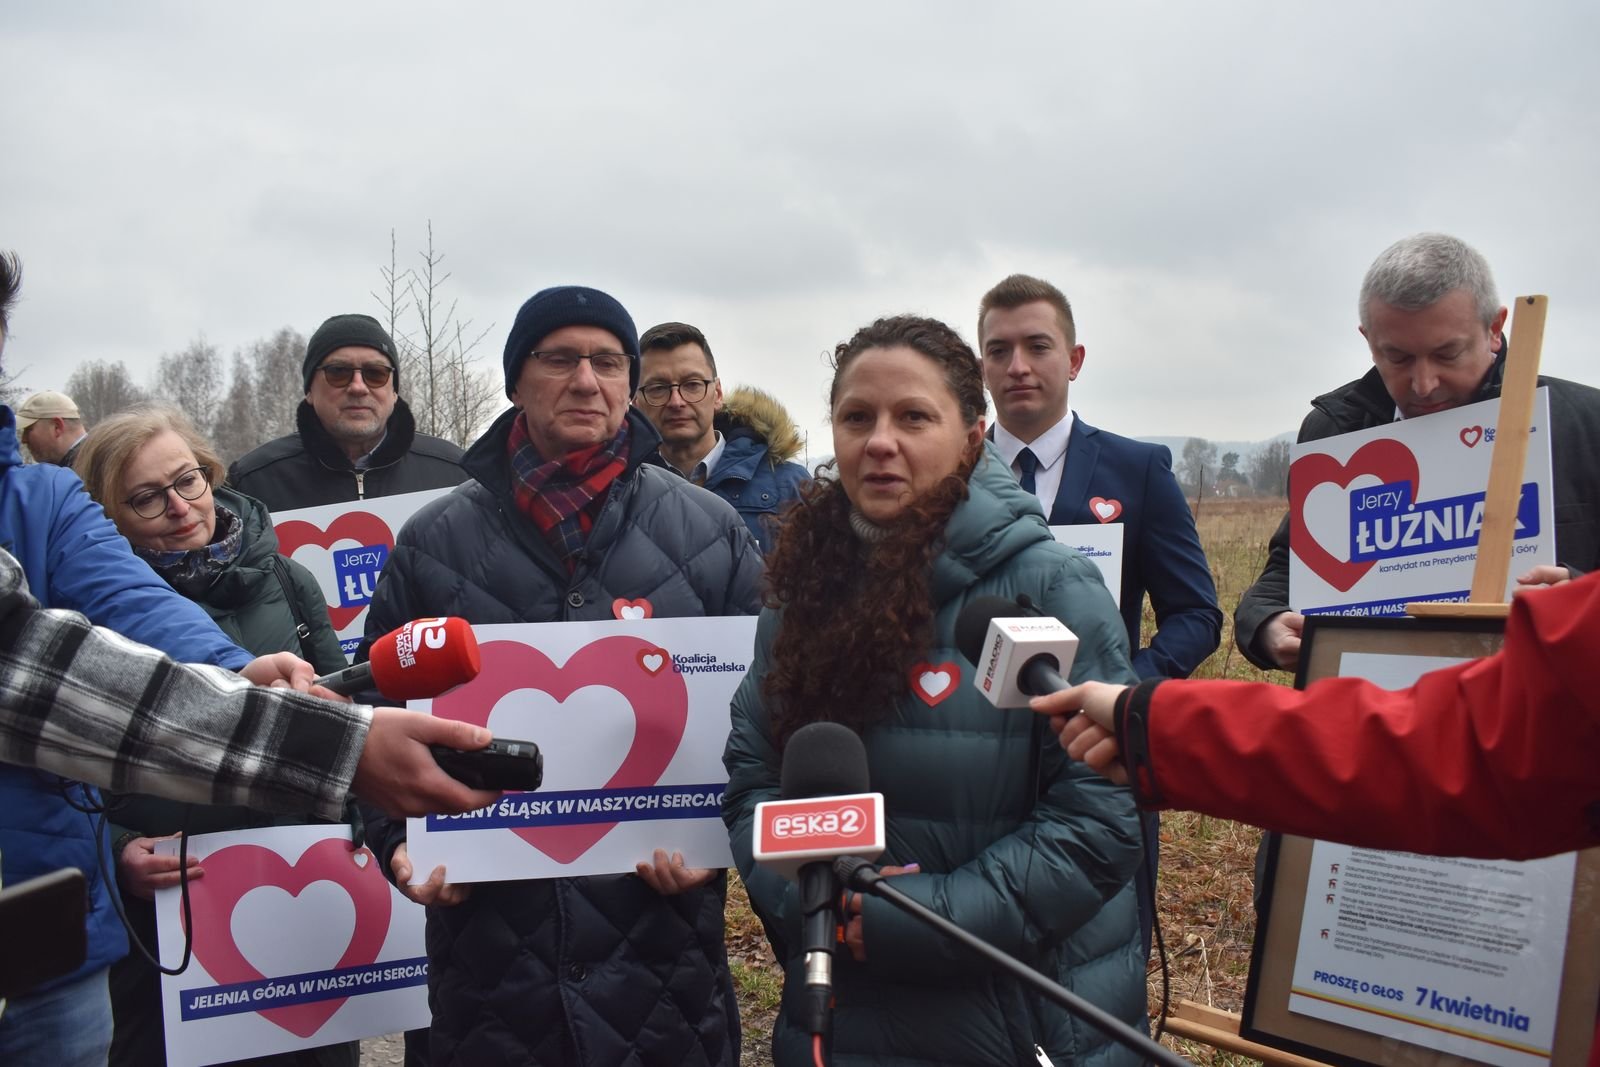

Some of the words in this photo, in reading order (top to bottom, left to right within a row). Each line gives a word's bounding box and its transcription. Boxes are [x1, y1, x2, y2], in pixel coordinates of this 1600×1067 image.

[1357, 490, 1402, 512] Jerzy
[1356, 495, 1526, 555] ŁUŻNIA
[341, 551, 381, 567] Jerzy
[1379, 560, 1418, 573] kandydat
[1516, 545, 1538, 557] Góry
[395, 633, 409, 668] RADIO
[672, 653, 717, 665] Koalicja
[987, 634, 1002, 677] RADIO
[672, 662, 746, 675] Obywatelska
[499, 798, 553, 820] ŚLĄSK
[556, 800, 574, 814] W
[577, 795, 660, 812] NASZYCH
[189, 990, 250, 1010] JELENIA
[252, 982, 297, 1001] GÓRA
[299, 980, 316, 994] W
[317, 970, 382, 990] NASZYCH
[1314, 970, 1359, 993] PROSZĘ
[1360, 981, 1370, 993] O
[1372, 984, 1404, 1001] GŁOS
[1415, 986, 1429, 1006] 7
[1430, 990, 1531, 1032] kwietnia
